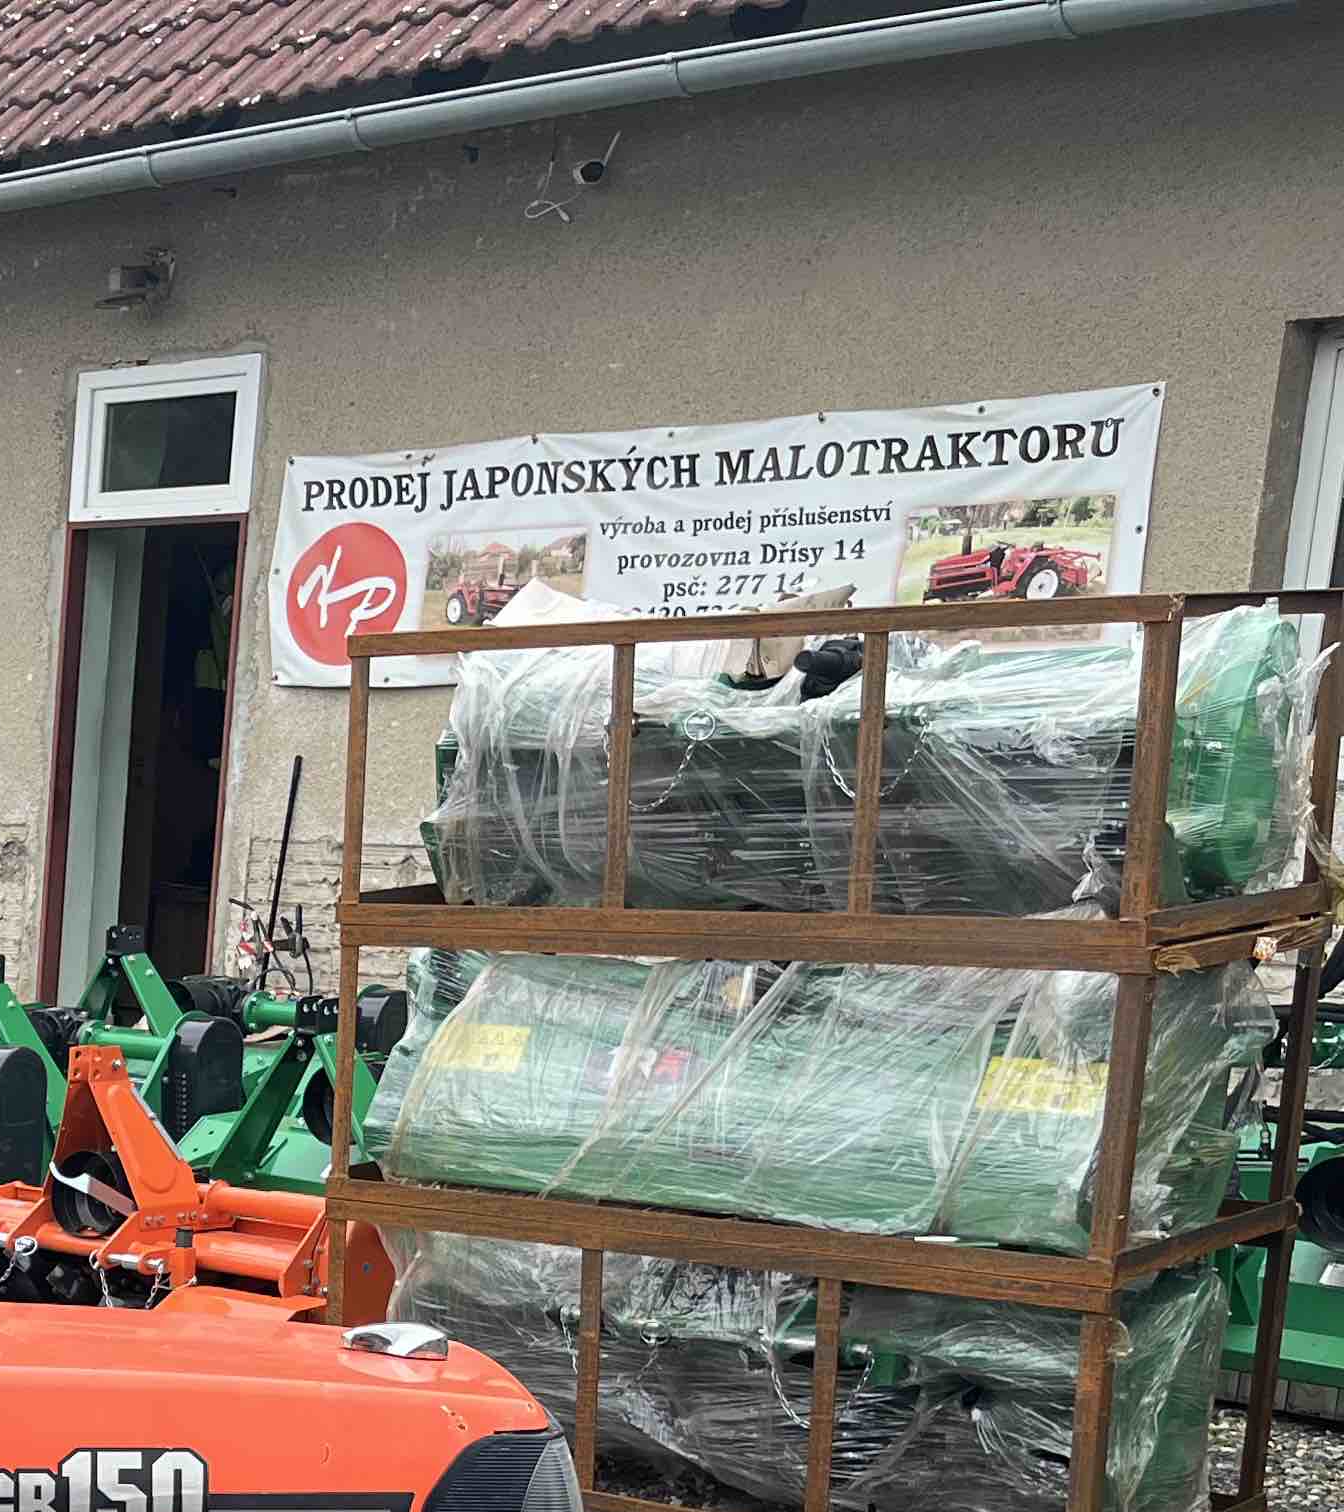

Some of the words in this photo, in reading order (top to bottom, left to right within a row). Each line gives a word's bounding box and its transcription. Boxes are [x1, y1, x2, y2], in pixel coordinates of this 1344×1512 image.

[302, 470, 430, 513] PRODEJ
[440, 446, 700, 512] JAPONSKÝCH
[715, 417, 1125, 487] MALOTRAKTORŮ
[600, 515, 666, 539] výroba
[674, 521, 686, 533] a
[693, 510, 752, 536] prodej
[760, 501, 894, 533] příslušenství
[617, 549, 750, 574] provozovna
[761, 541, 824, 567] Dřísy
[833, 538, 865, 561] 14
[663, 576, 707, 602] psč:
[716, 574, 767, 596] 277
